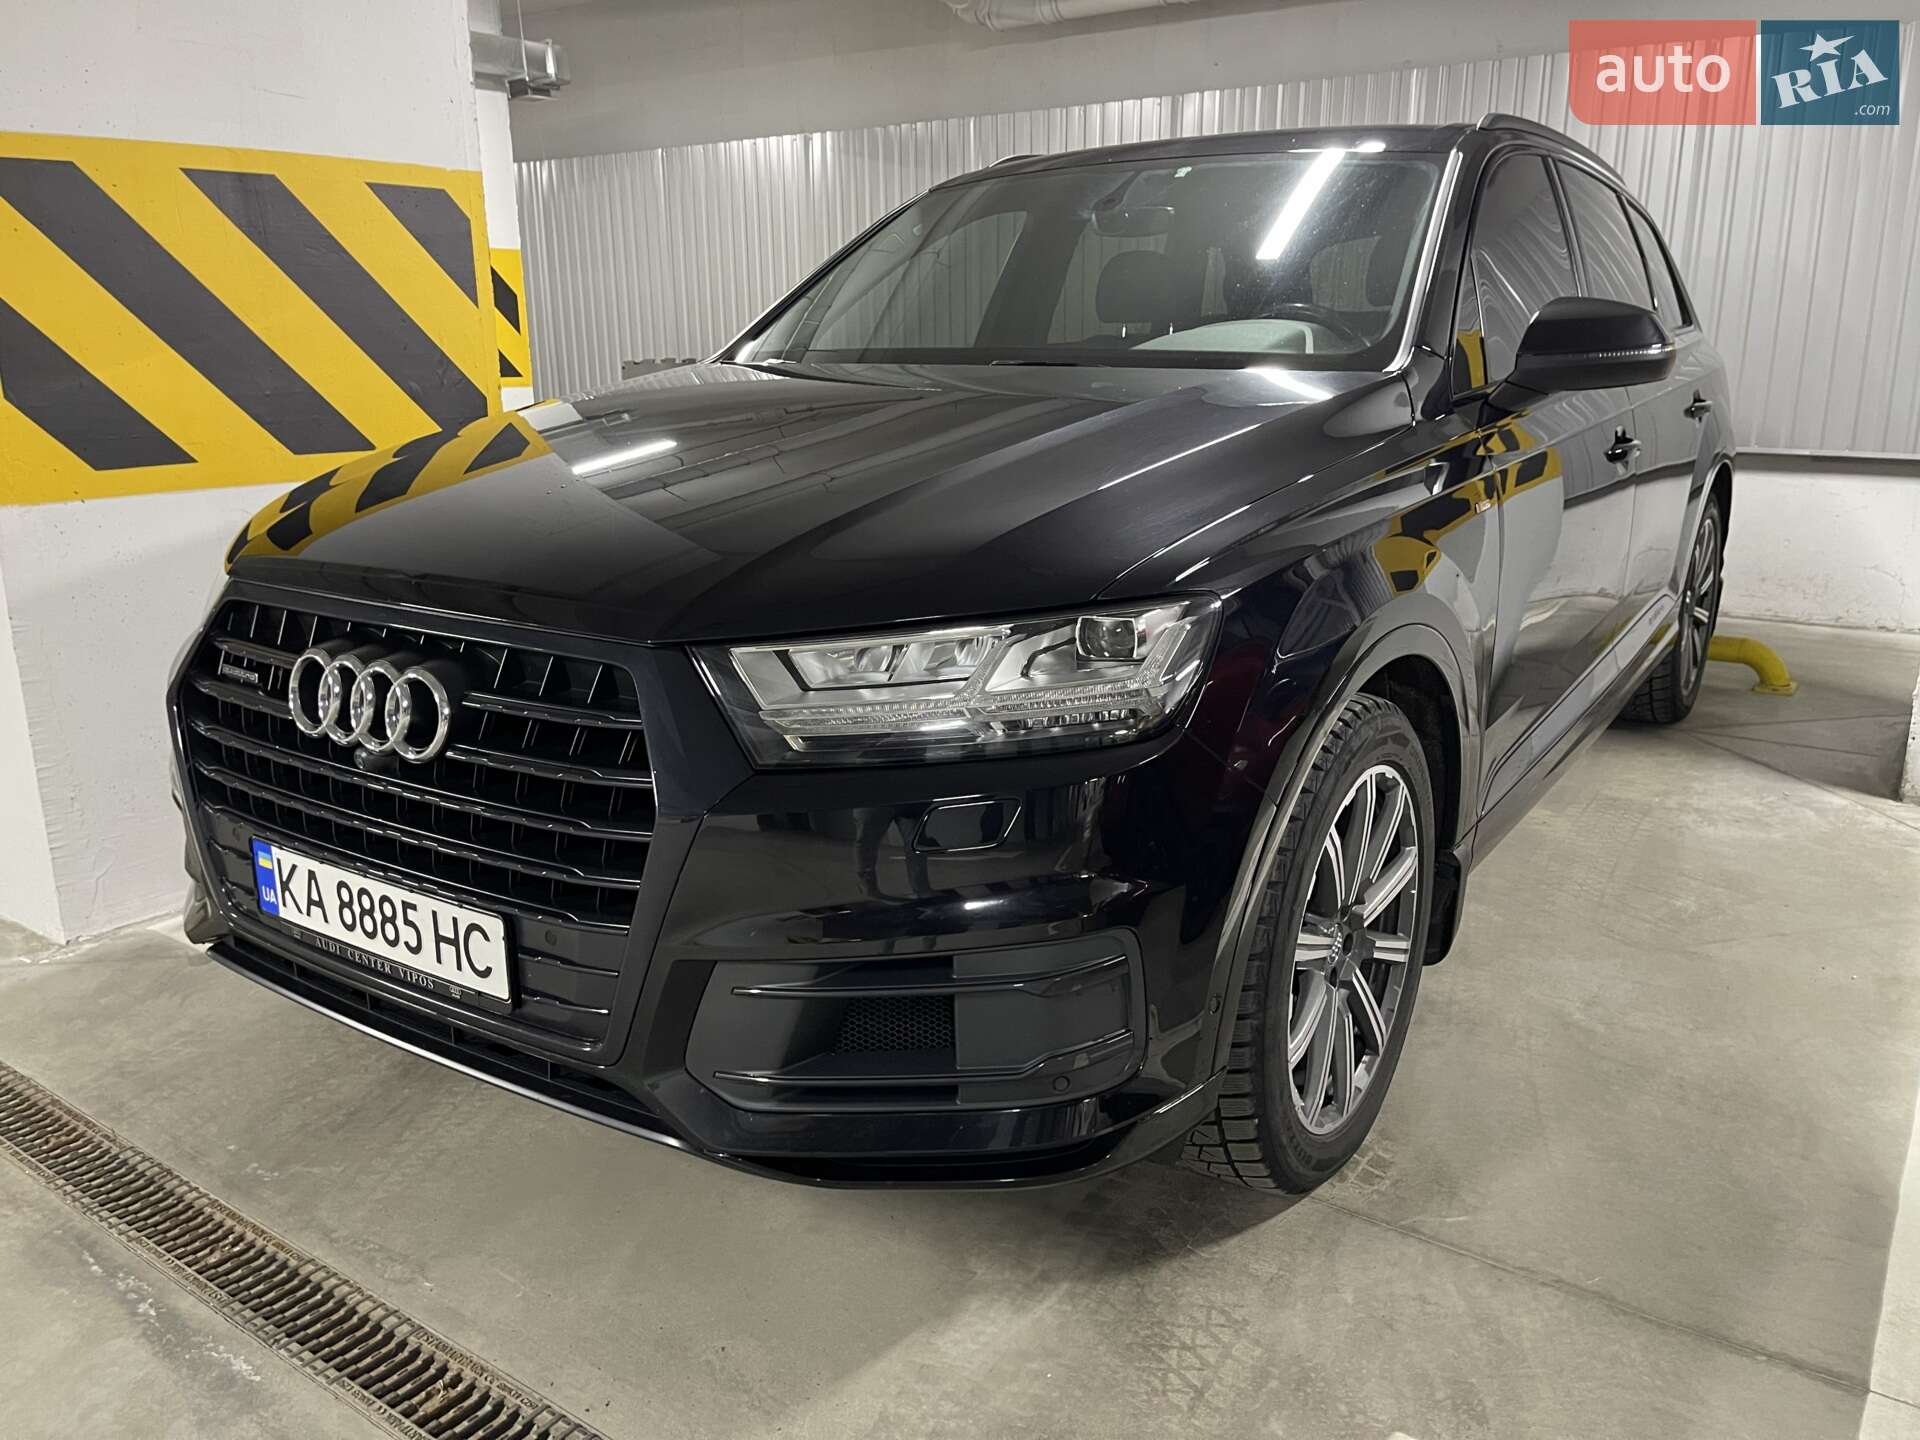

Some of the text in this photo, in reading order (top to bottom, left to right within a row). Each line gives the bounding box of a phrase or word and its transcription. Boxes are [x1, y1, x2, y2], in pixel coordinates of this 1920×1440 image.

[262, 886, 277, 905] UA
[276, 857, 492, 979] KA 8885 HC
[315, 936, 434, 990] AUDI CENTER VIPOS
